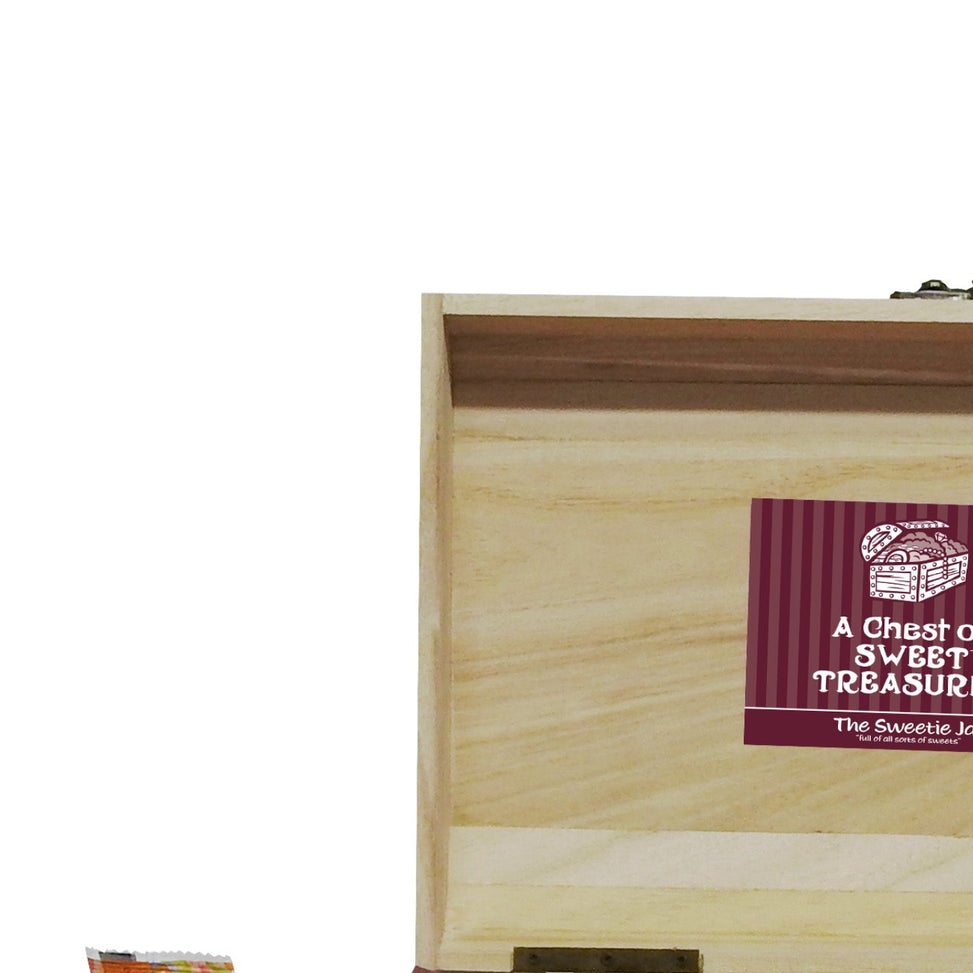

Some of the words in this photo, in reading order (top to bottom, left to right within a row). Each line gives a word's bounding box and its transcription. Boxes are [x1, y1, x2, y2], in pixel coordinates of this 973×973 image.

[832, 616, 854, 638] A
[863, 617, 951, 642] Chest
[854, 643, 969, 669] SWEET
[833, 717, 870, 733] The
[874, 718, 951, 737] Sweetie
[883, 735, 893, 743] all
[894, 735, 917, 745] sorts
